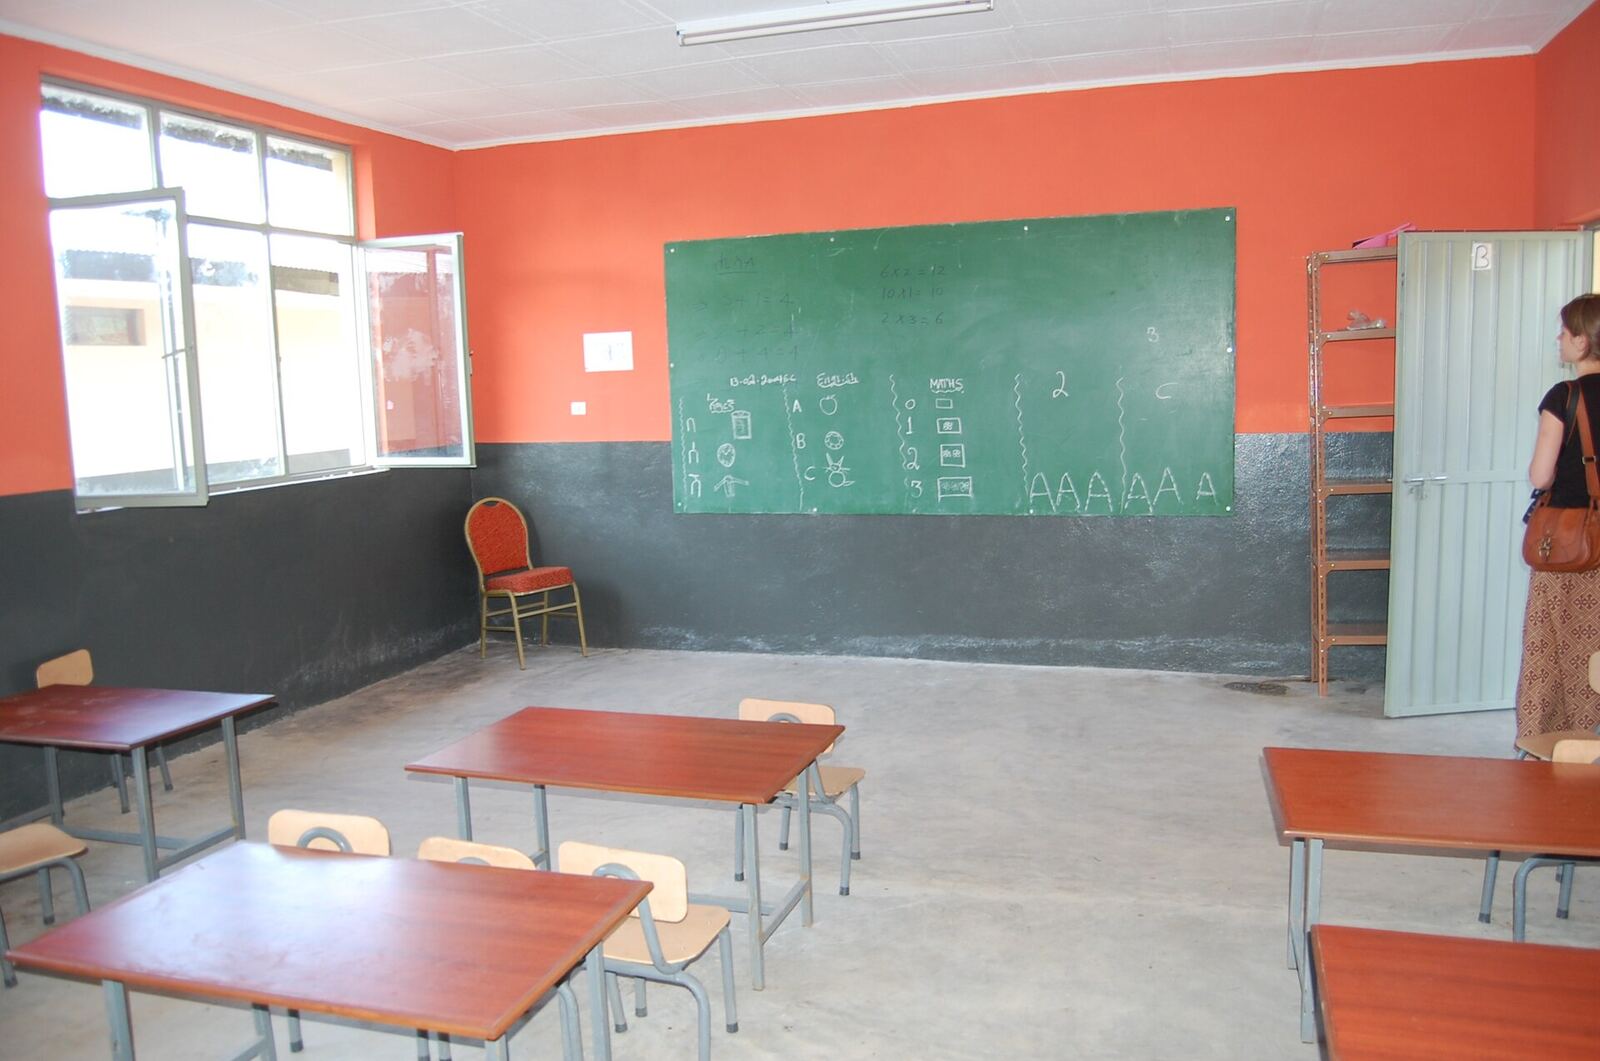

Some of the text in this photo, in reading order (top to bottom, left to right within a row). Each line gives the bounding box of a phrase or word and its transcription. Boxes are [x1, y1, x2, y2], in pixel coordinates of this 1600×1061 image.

[1475, 245, 1490, 268] B
[1146, 327, 1160, 343] 3
[929, 377, 964, 391] MATHS
[1052, 370, 1069, 398] 2
[792, 399, 802, 413] A
[905, 416, 913, 435] 1
[796, 432, 806, 449] B
[906, 447, 920, 470] 2
[804, 465, 816, 481] C
[910, 480, 923, 498] 3
